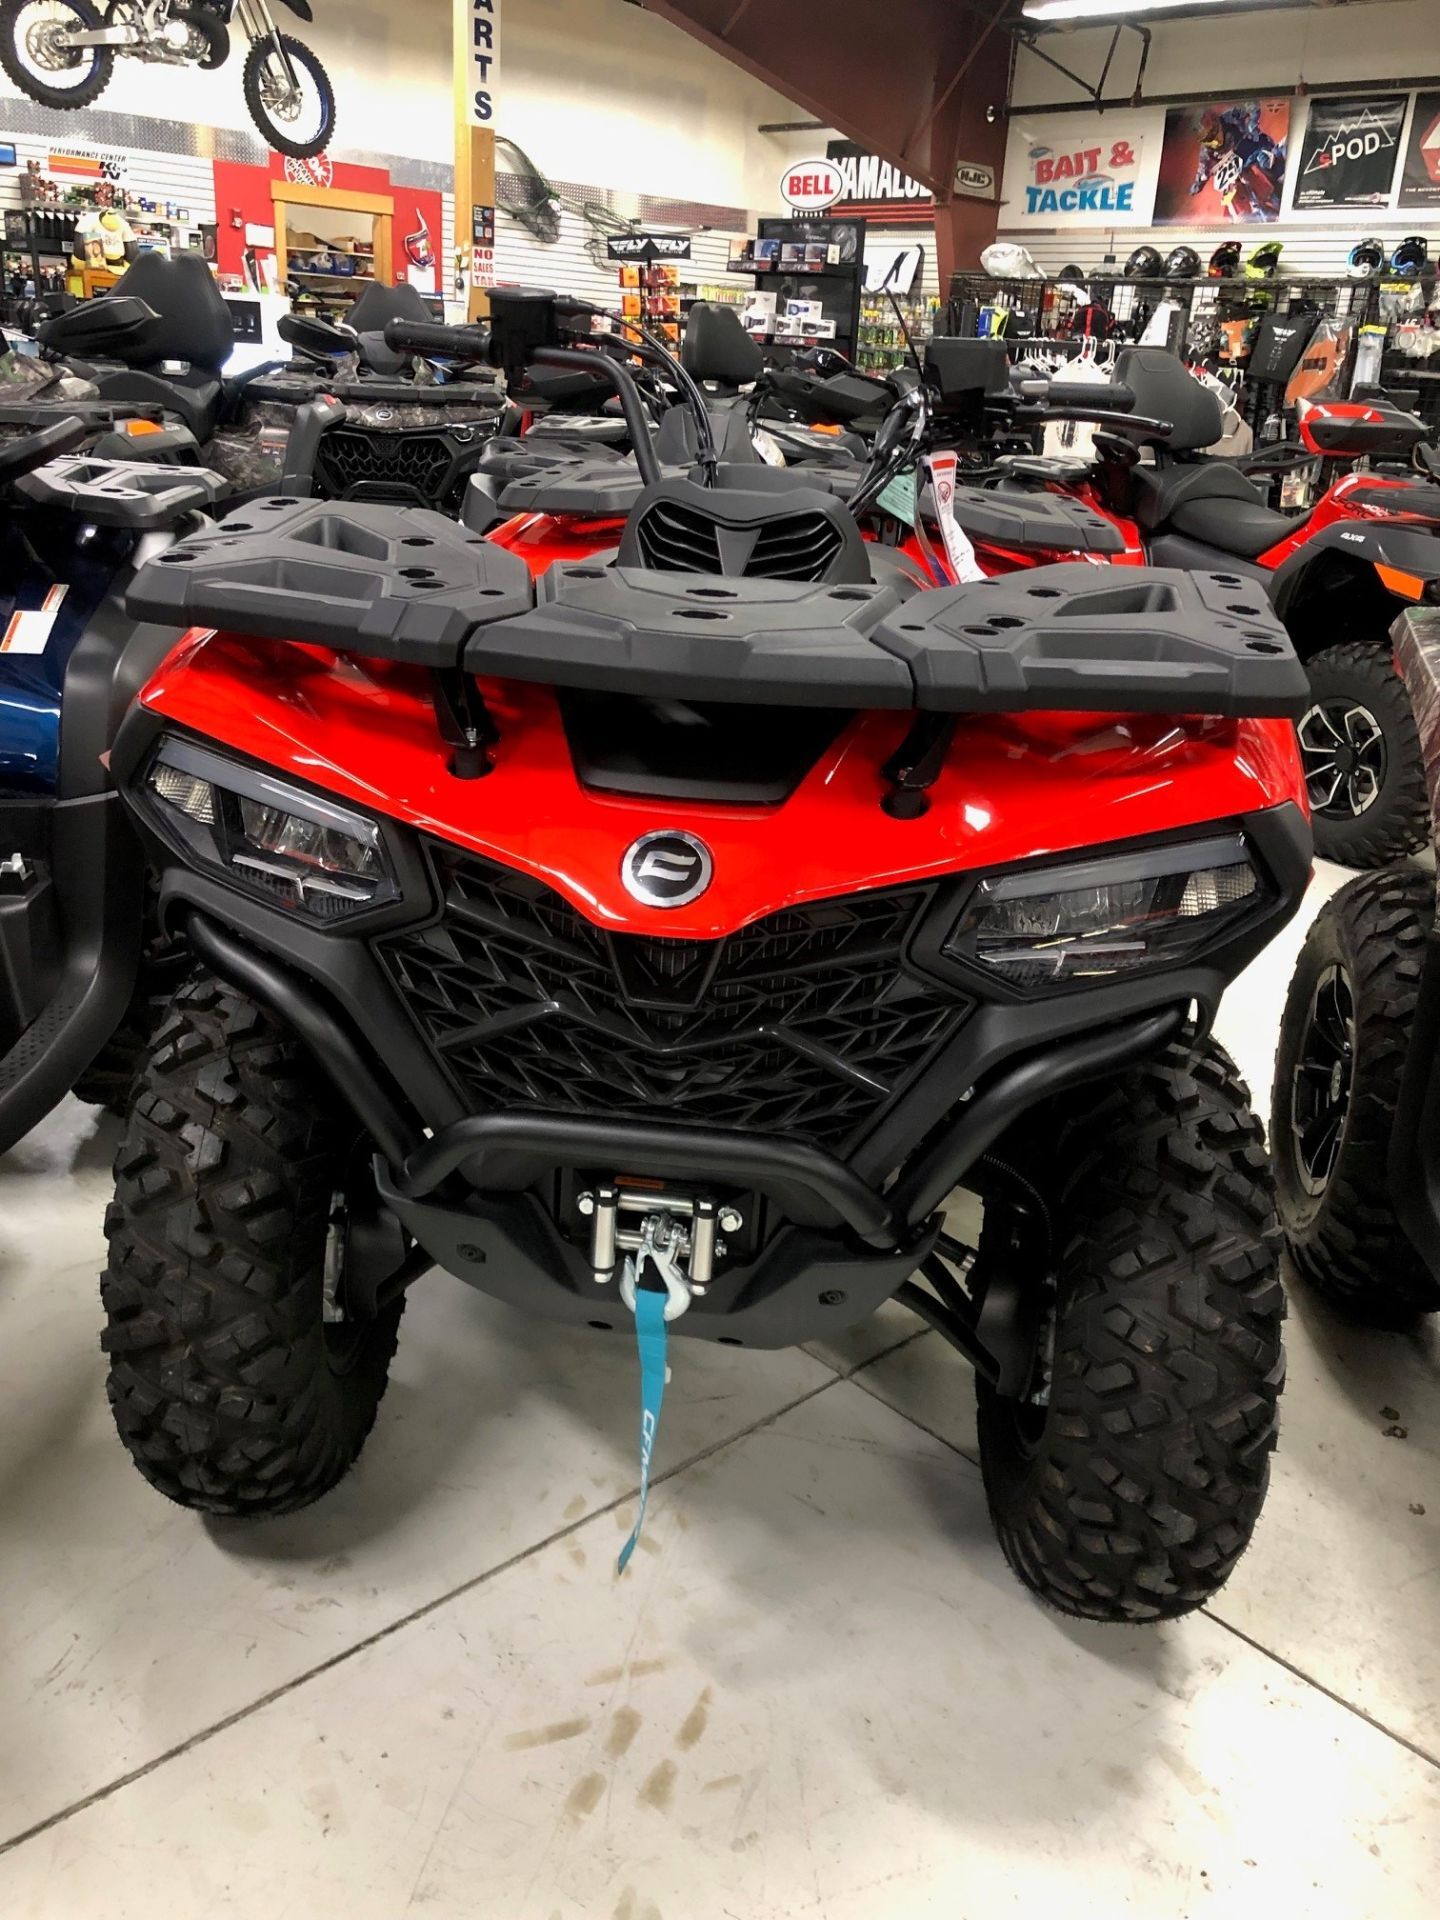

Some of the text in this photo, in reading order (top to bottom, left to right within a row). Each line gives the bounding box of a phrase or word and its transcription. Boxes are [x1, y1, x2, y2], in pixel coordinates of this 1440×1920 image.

[49, 146, 127, 162] PERFORMANCE CENTER
[1035, 141, 1135, 186] BAIT &
[960, 170, 986, 184] HJC
[789, 174, 834, 196] BELL
[1025, 181, 1135, 214] TACKLE
[608, 238, 650, 252] FLY
[650, 238, 690, 253] FLY
[474, 248, 493, 260] NO
[473, 262, 494, 274] SALES
[474, 275, 495, 287] TAX
